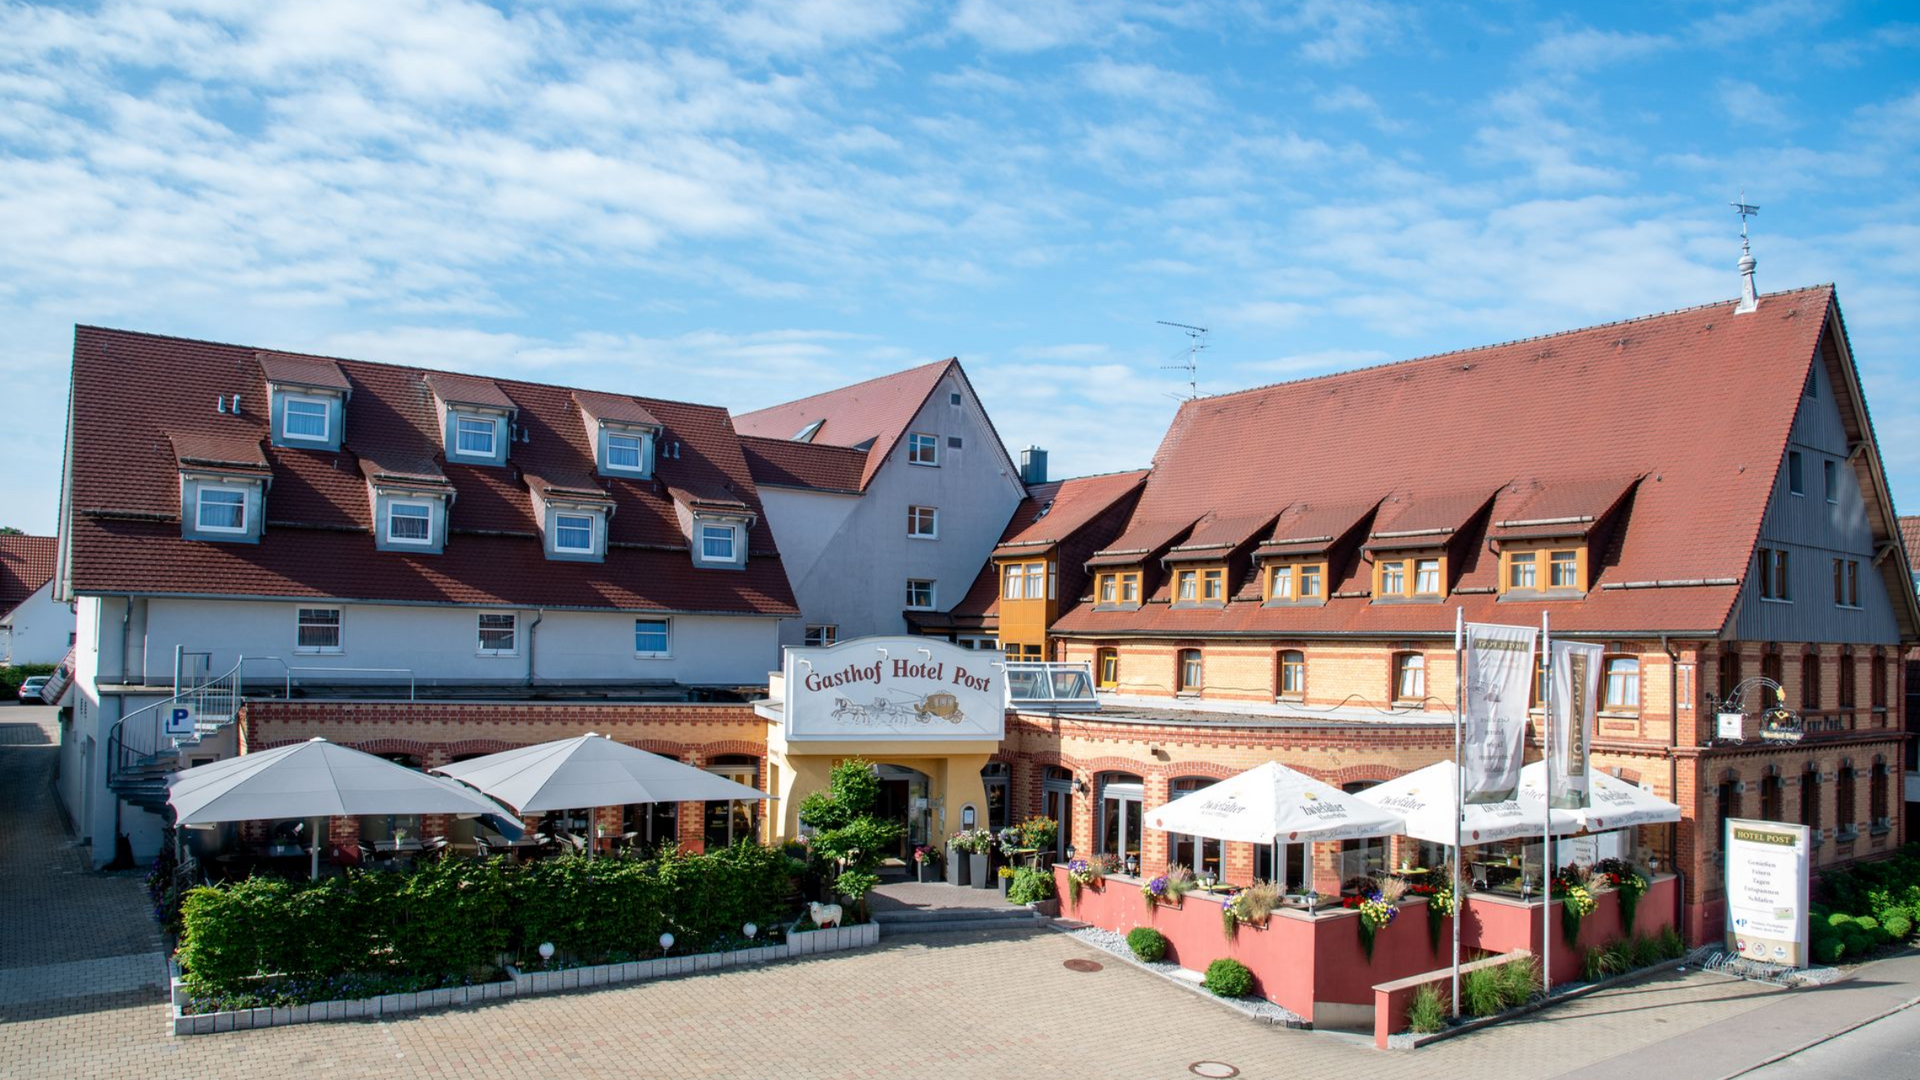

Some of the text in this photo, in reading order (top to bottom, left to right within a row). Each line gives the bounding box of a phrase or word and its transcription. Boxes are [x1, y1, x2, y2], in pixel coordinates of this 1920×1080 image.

[805, 659, 991, 692] Gasthof Hotel Post
[172, 708, 189, 726] P
[1737, 830, 1791, 844] HOTEL POST
